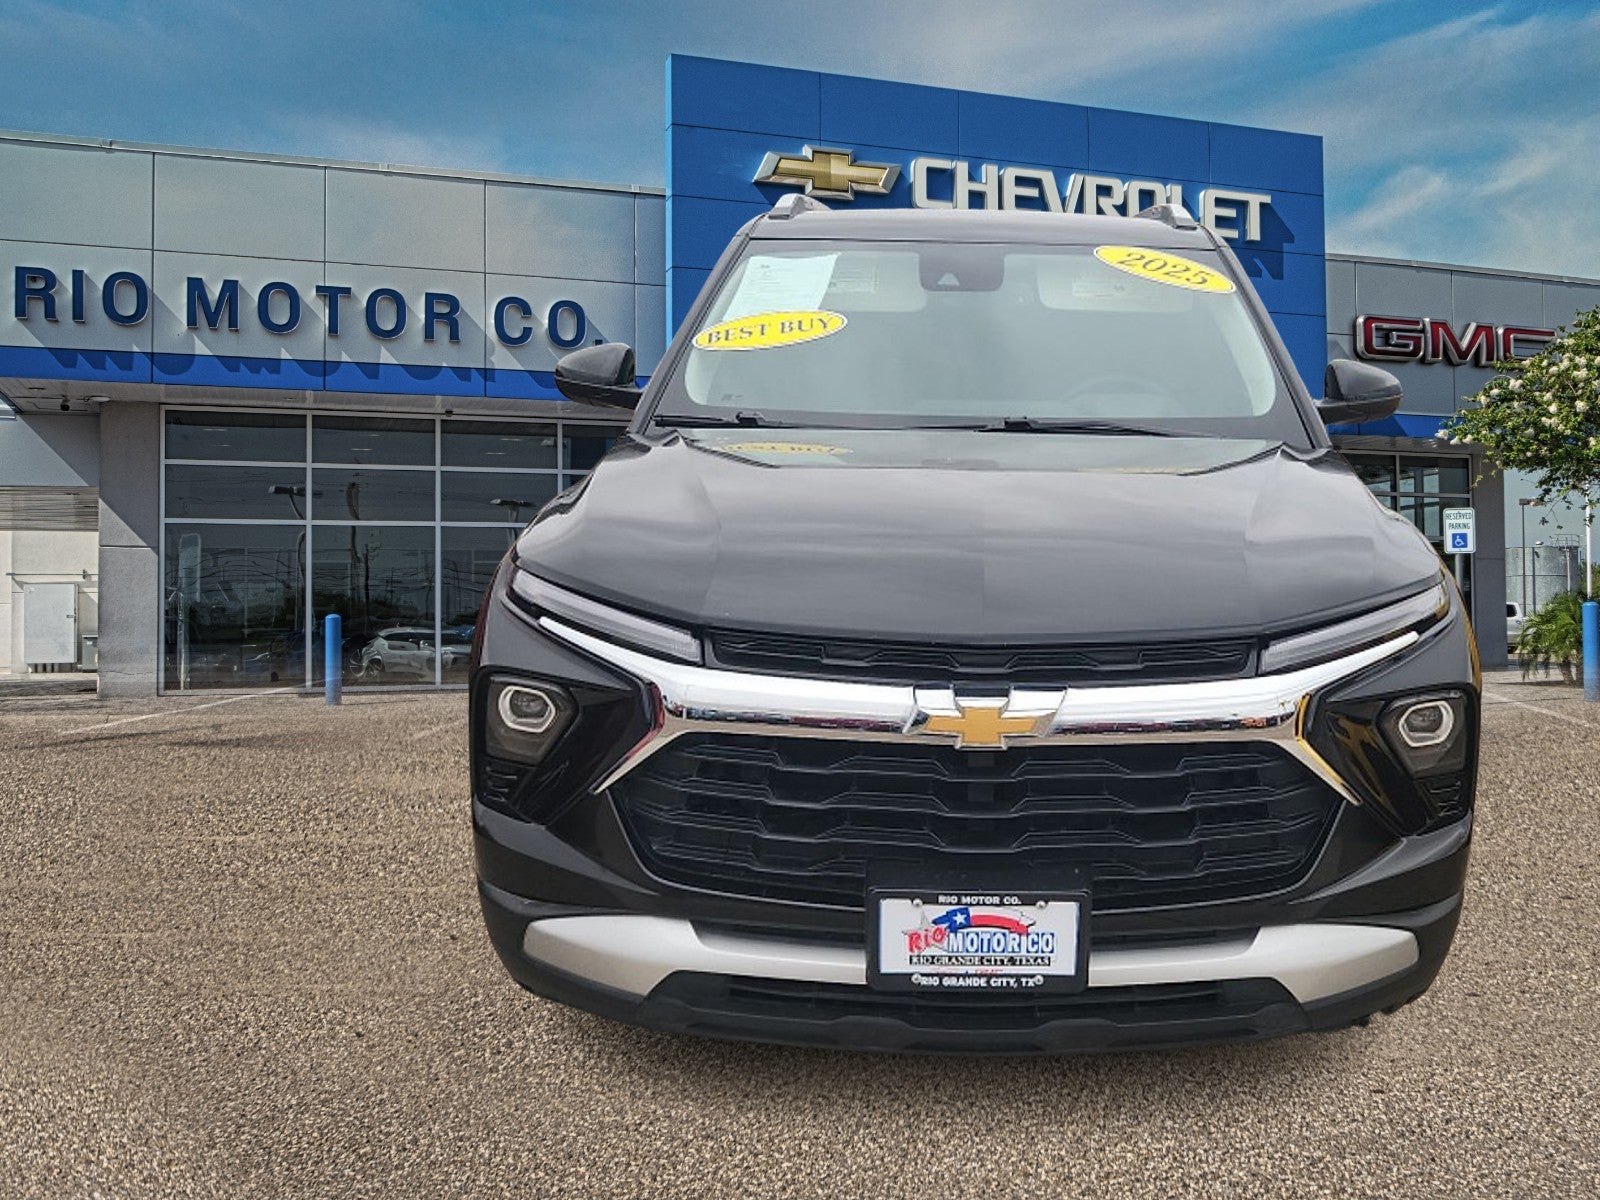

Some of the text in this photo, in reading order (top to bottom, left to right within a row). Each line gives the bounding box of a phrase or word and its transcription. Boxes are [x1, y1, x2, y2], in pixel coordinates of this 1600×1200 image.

[1117, 251, 1210, 287] 2025
[14, 266, 150, 326] RIO
[187, 277, 461, 342] MOTOR
[707, 316, 834, 345] BEST BUY
[1355, 314, 1557, 367] GMC
[1446, 512, 1472, 520] RESERVED
[1448, 522, 1471, 530] PARKING
[938, 895, 1022, 905] RIO MOTOR CO.
[948, 932, 1021, 954] MOTOR
[1026, 932, 1055, 954] CO
[935, 955, 981, 966] GRANDE
[1015, 956, 1049, 966] TEXAS
[942, 976, 987, 987] GRANDE
